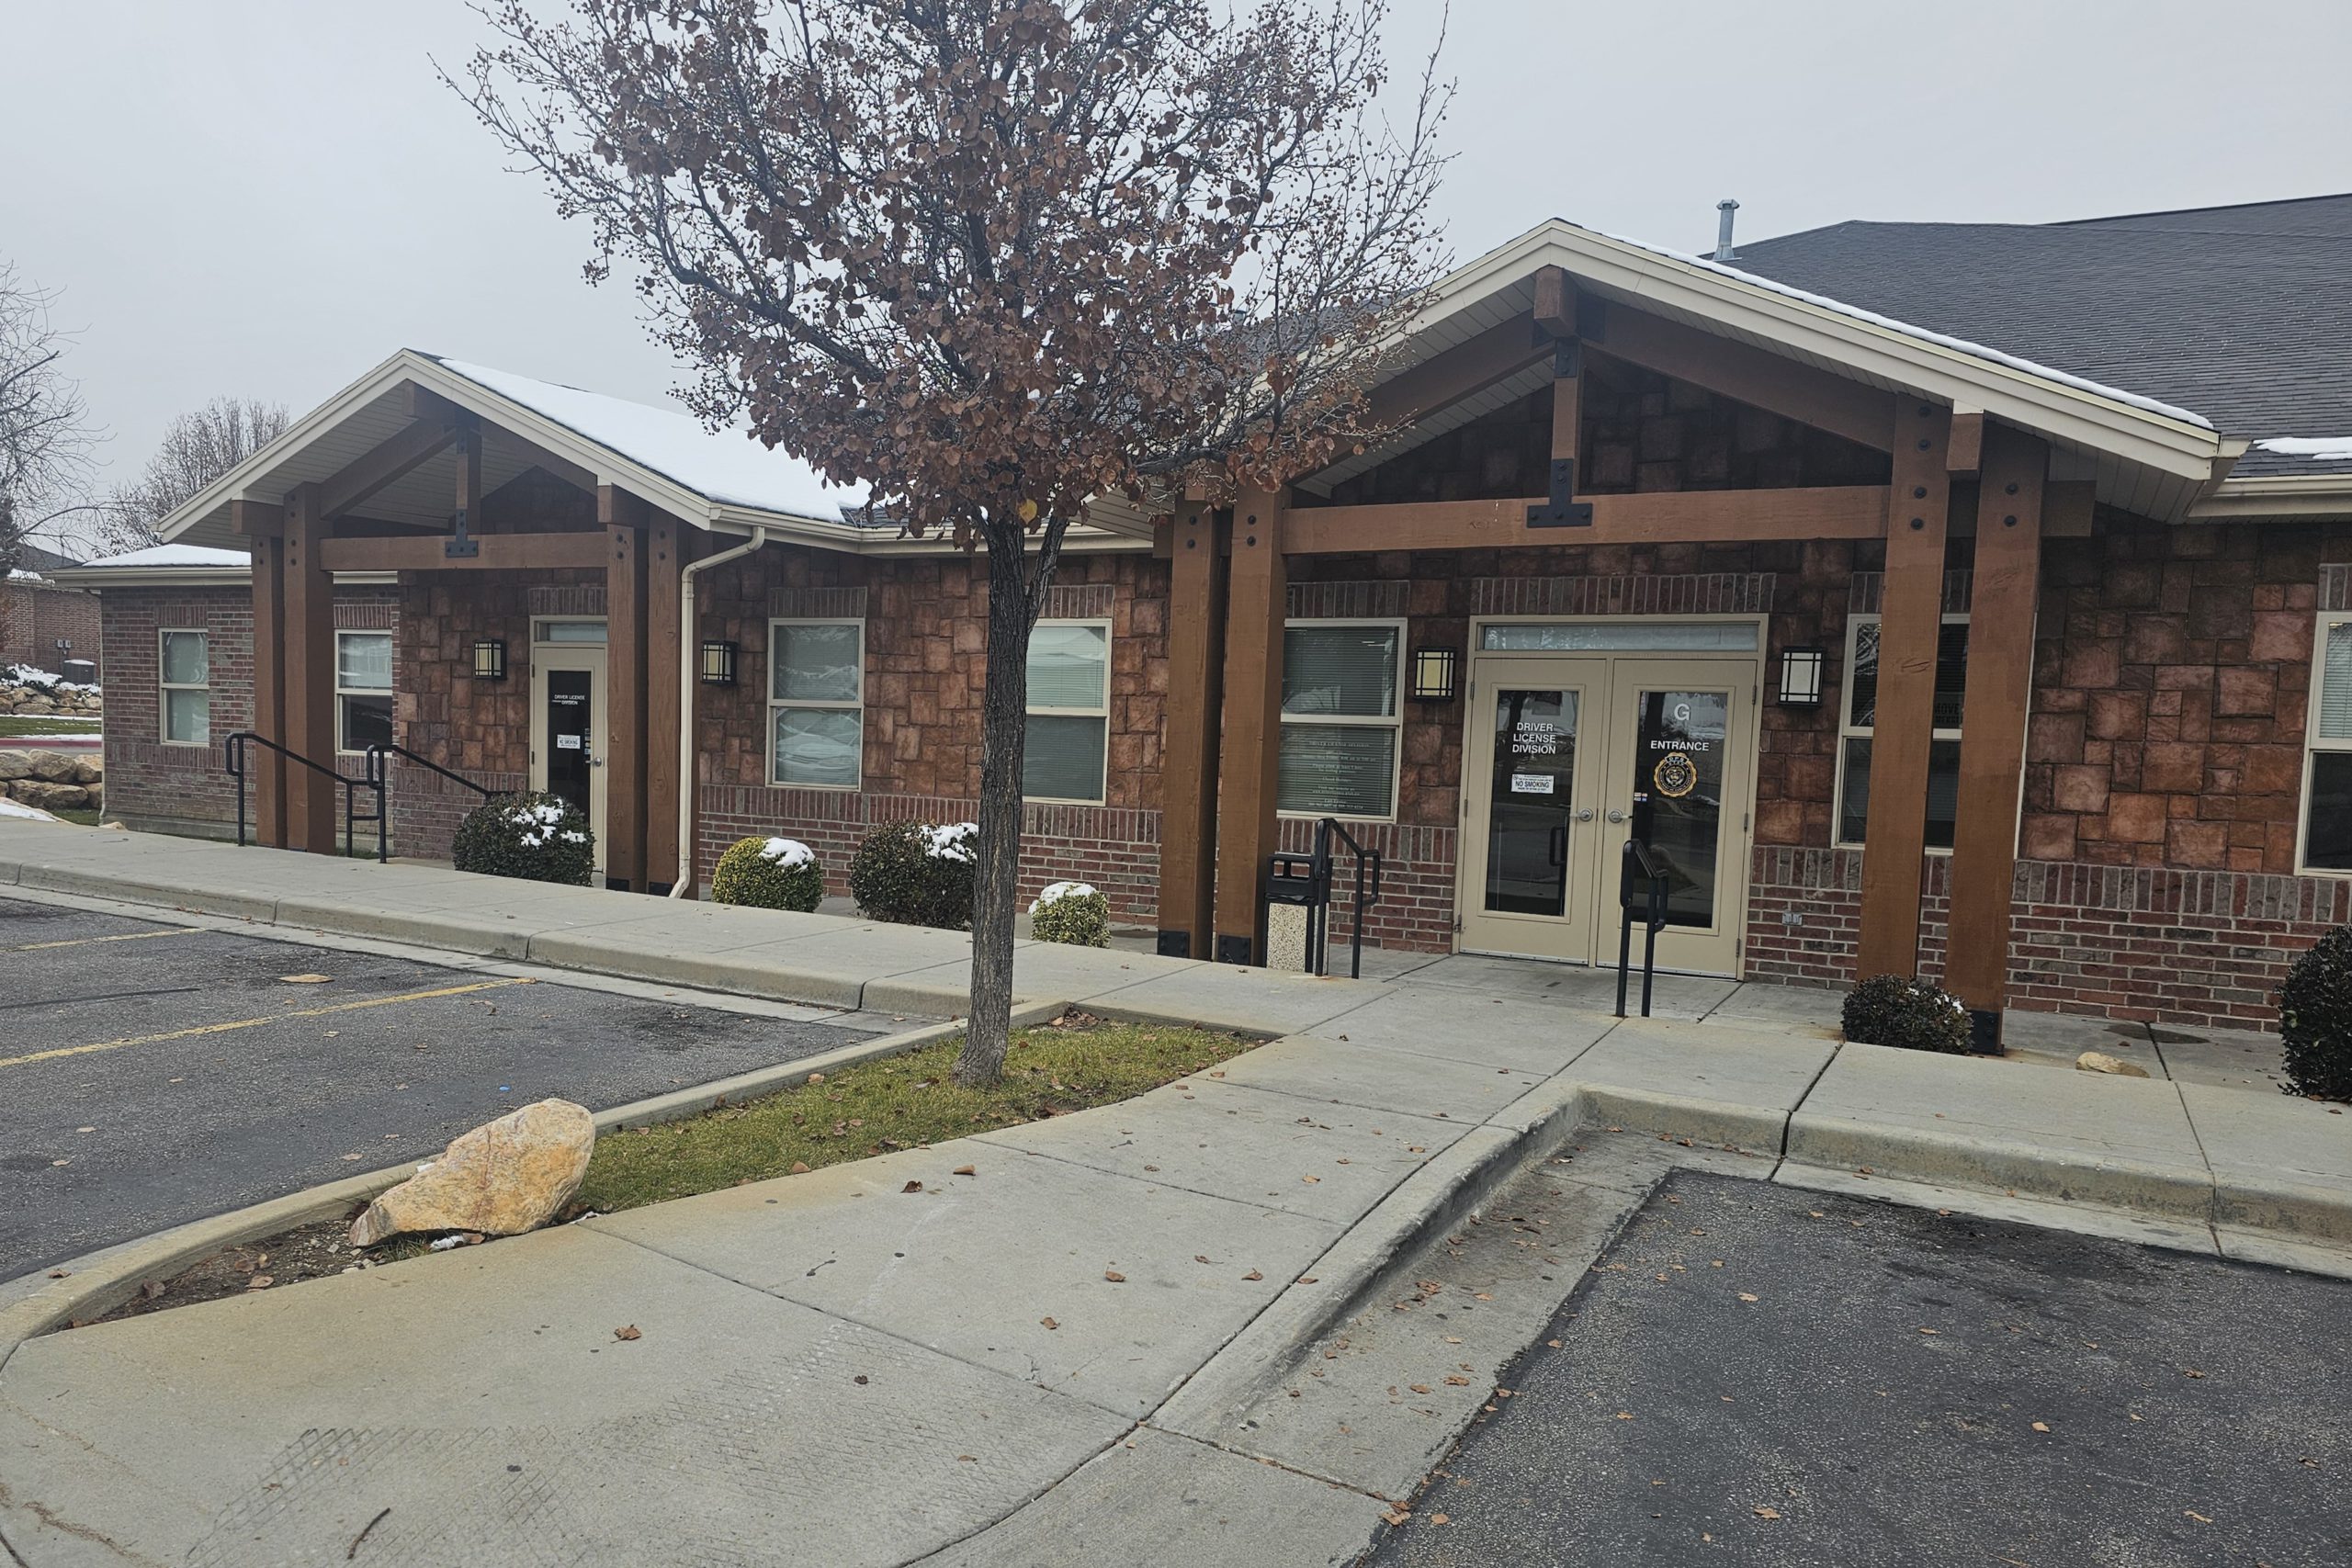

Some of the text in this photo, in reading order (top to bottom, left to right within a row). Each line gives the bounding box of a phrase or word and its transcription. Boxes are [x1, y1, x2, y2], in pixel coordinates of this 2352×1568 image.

[1674, 703, 1690, 721] G
[1517, 722, 1553, 731] DRIVER
[1513, 733, 1555, 742] LICENSE
[1512, 744, 1555, 754] DIVISION
[1650, 740, 1709, 750] ENTRANCE
